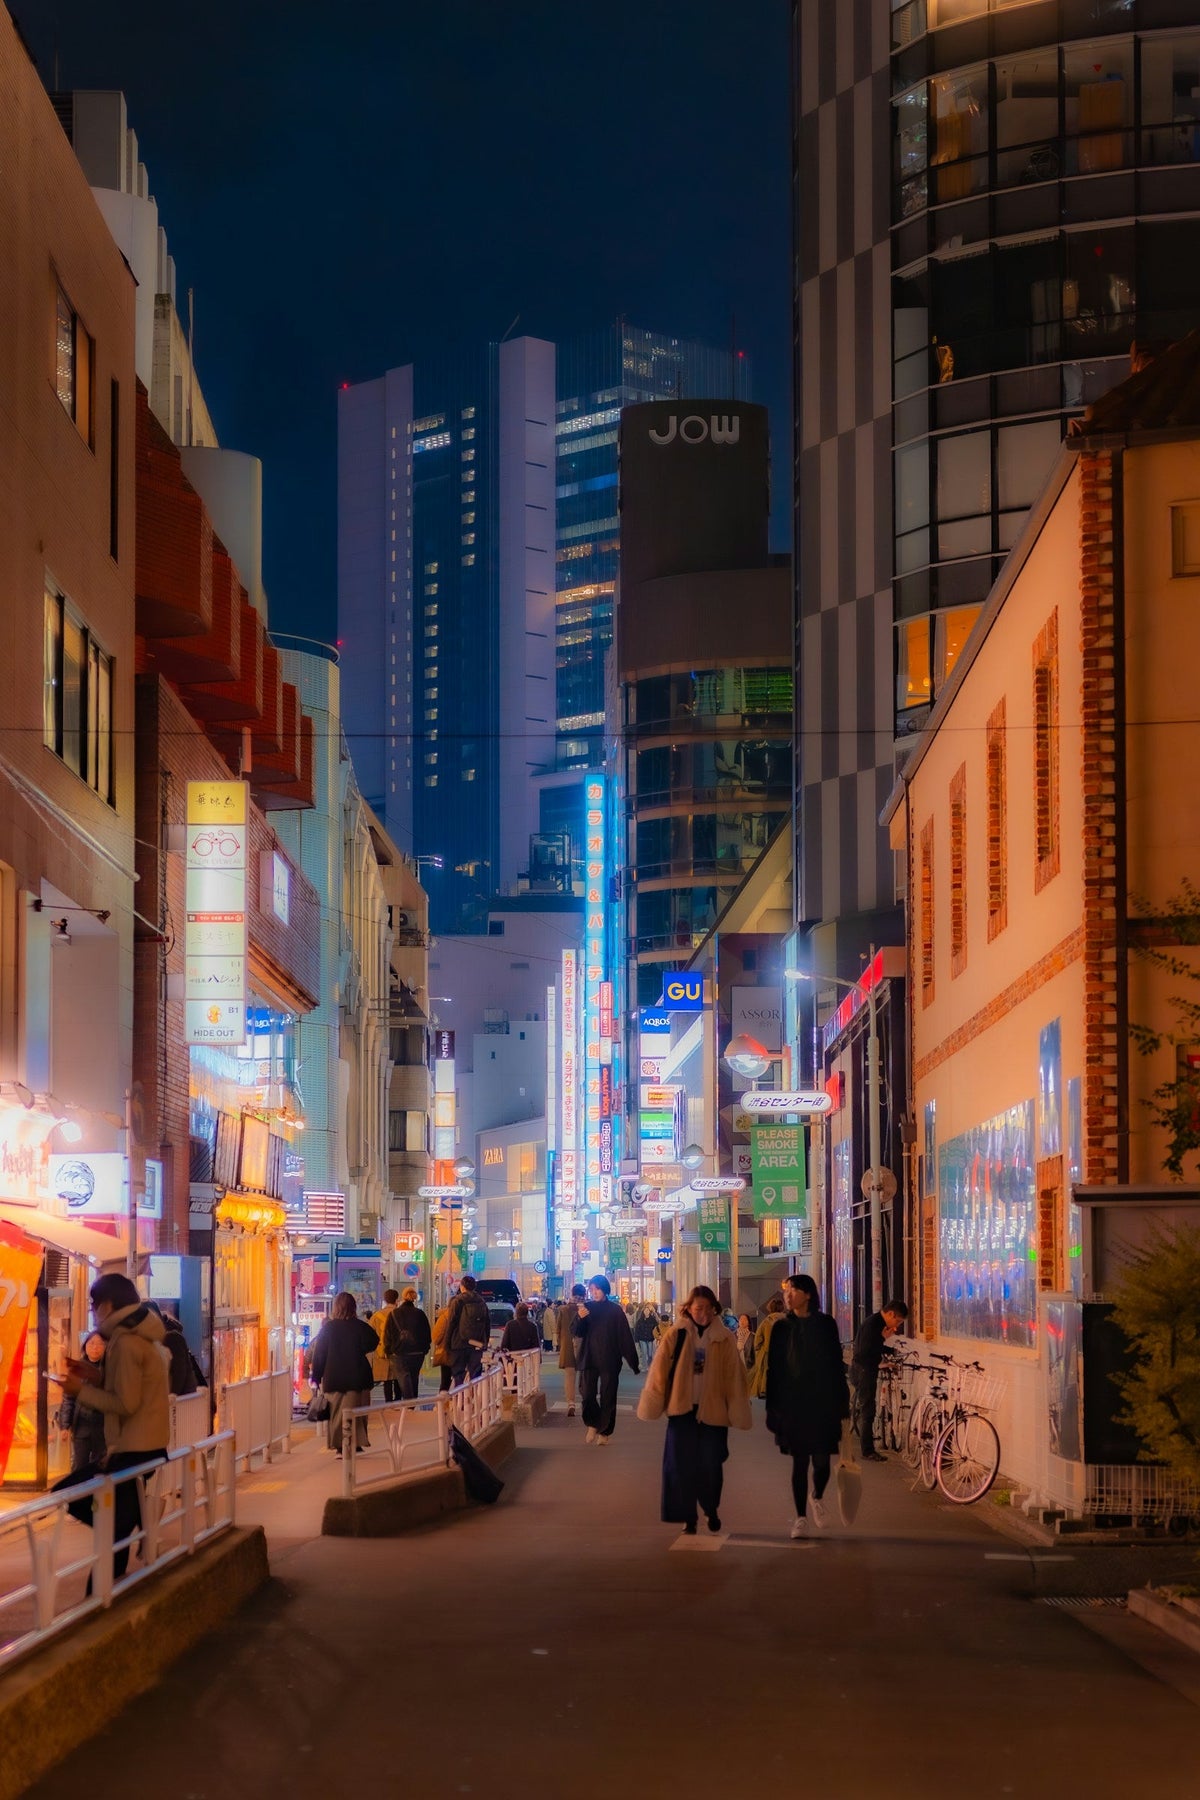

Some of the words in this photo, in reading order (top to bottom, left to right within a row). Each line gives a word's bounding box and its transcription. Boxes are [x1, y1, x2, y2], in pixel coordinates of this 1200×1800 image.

[649, 415, 740, 445] JOW
[564, 959, 573, 989] カラオケ
[667, 982, 700, 1001] GU
[193, 1029, 215, 1037] HIDE
[216, 1029, 235, 1037] OUT
[564, 1058, 573, 1088] カラオケ
[748, 1096, 826, 1108] 渋谷センター街
[756, 1129, 798, 1139] PLEASE
[757, 1140, 799, 1150] SMOKE
[484, 1147, 504, 1166] ZARA
[758, 1156, 799, 1168] AREA
[564, 1154, 574, 1202] カラオケ
[693, 1180, 743, 1188] 渋谷センター街
[408, 1234, 423, 1250] P
